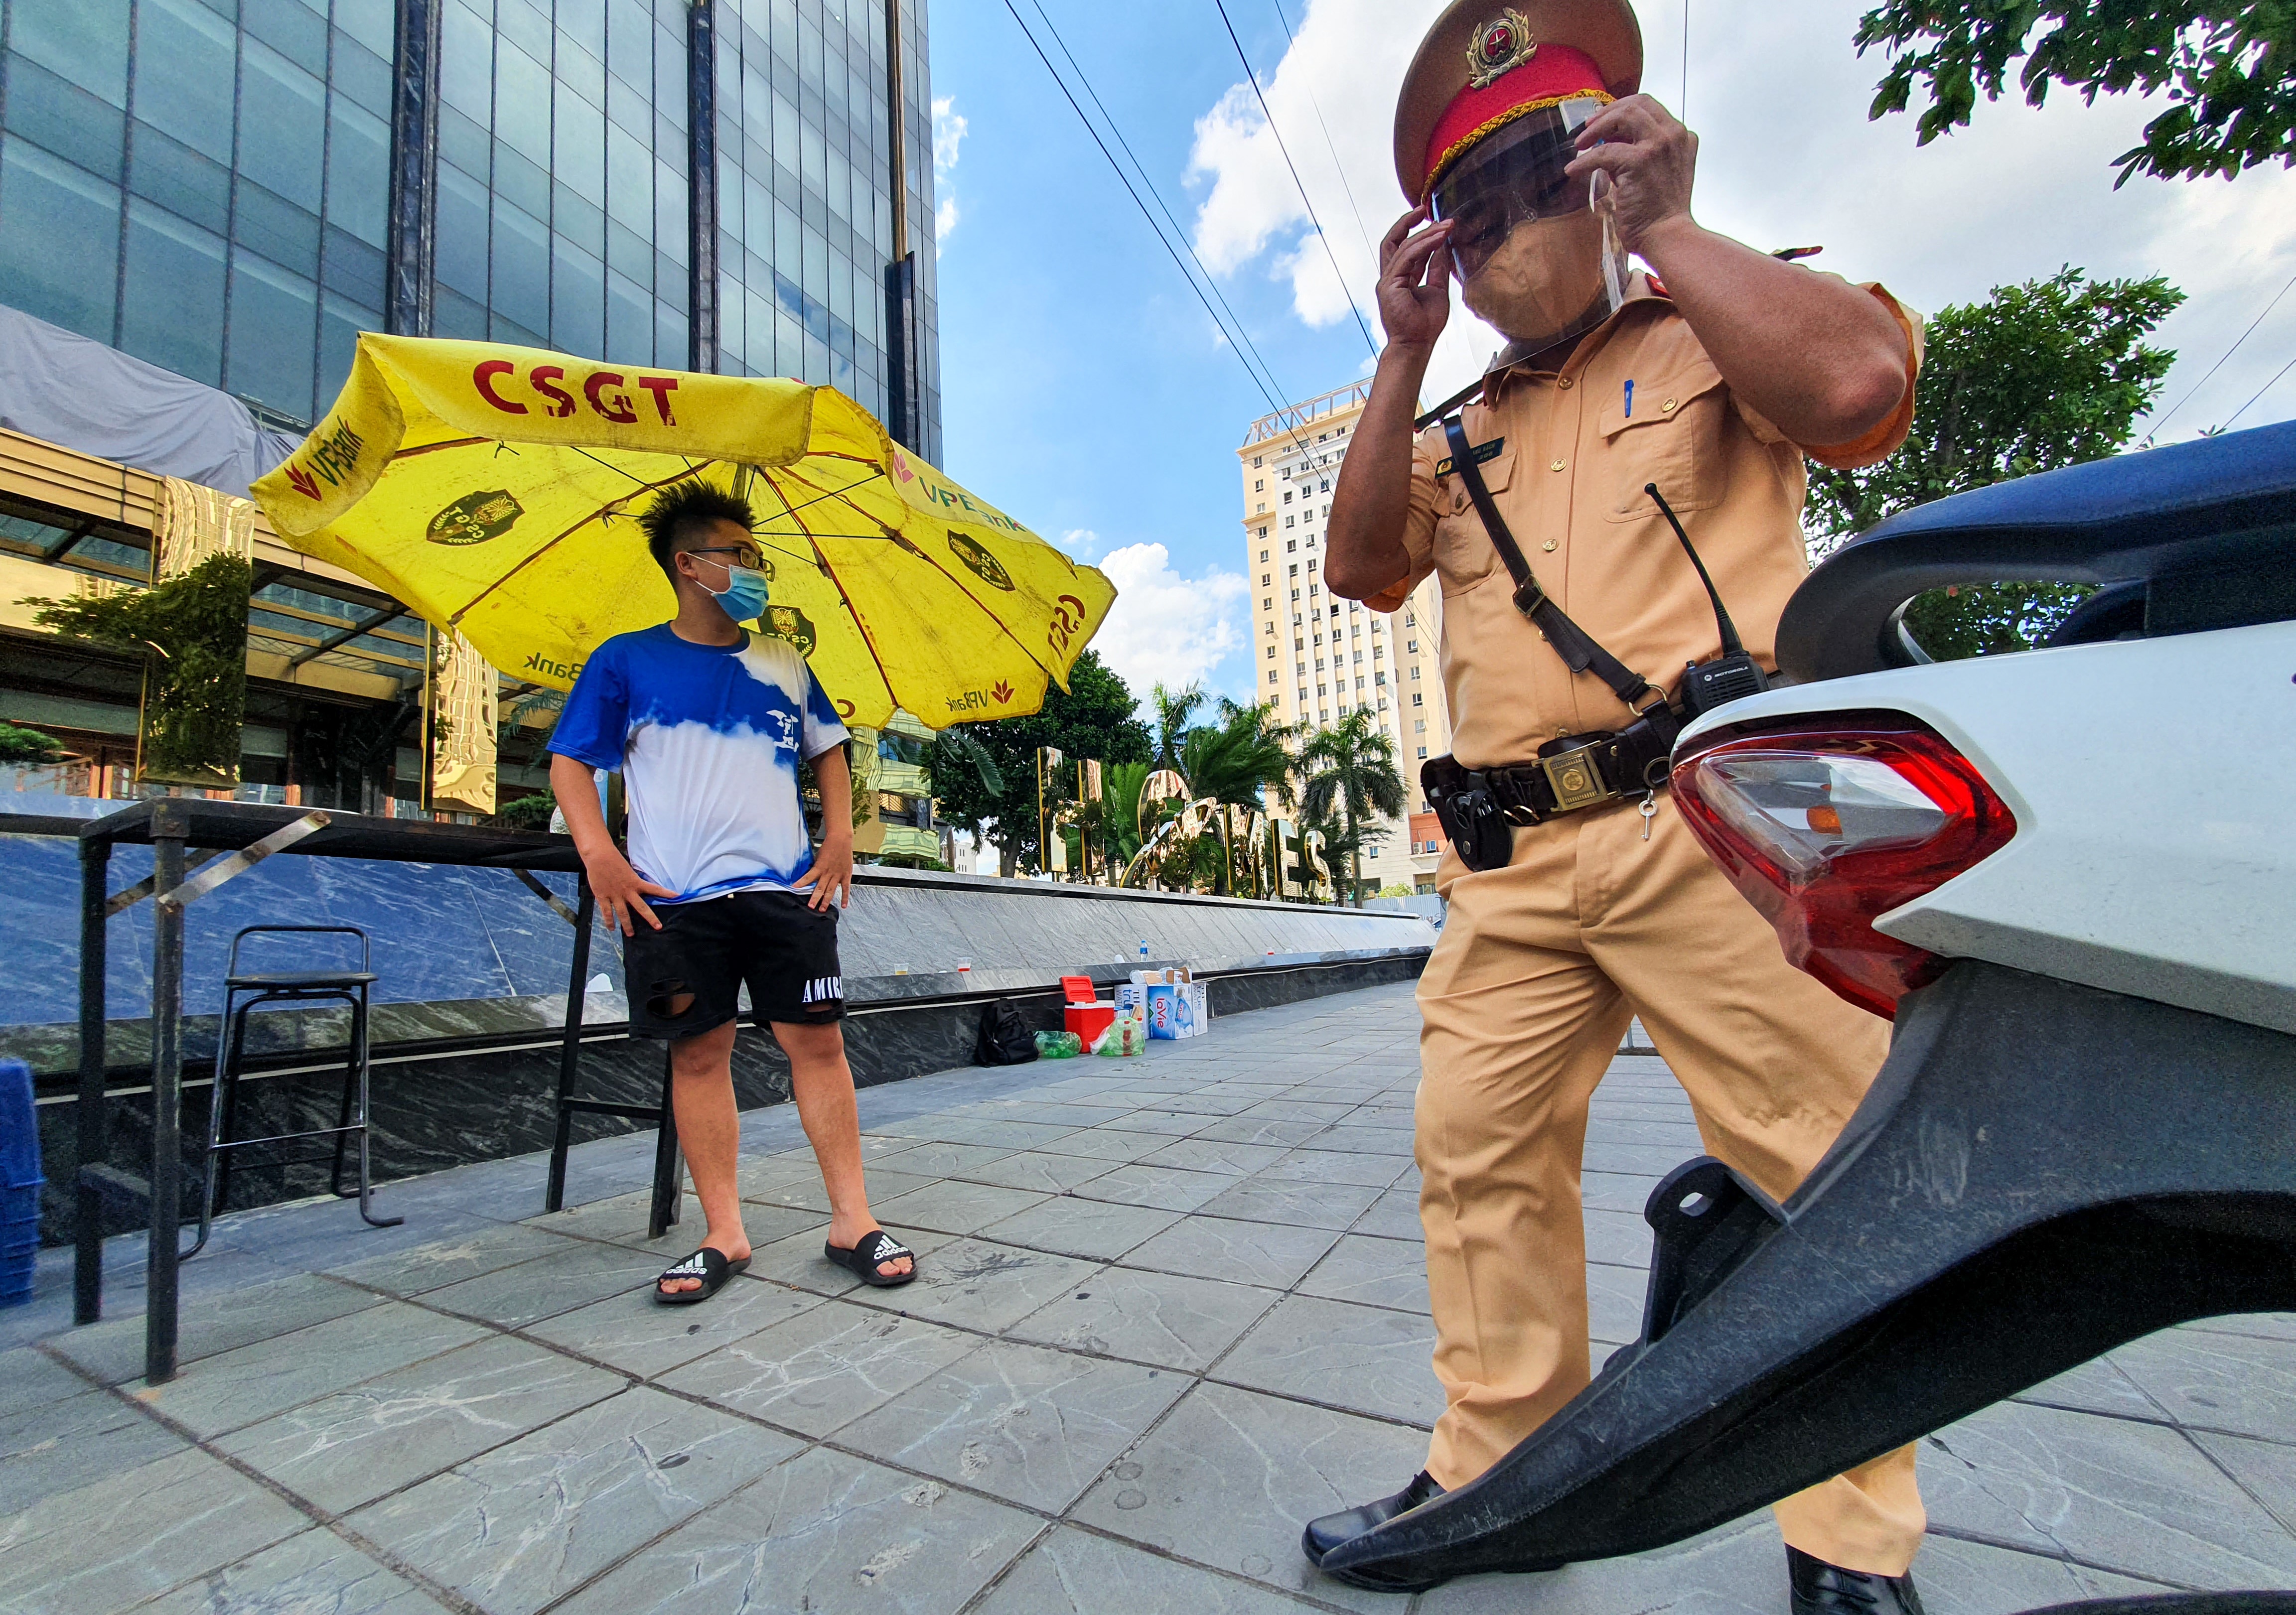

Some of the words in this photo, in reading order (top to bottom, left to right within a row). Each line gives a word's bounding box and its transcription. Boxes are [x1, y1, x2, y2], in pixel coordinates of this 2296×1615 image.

[473, 360, 678, 426] CSGT
[306, 414, 364, 486] VPBank
[1714, 666, 1748, 677] MOTOROLA
[802, 976, 844, 1002] AMIRI
[1123, 989, 1132, 1005] tru
[873, 1246, 909, 1260] adidas
[666, 1266, 708, 1275] adidas
